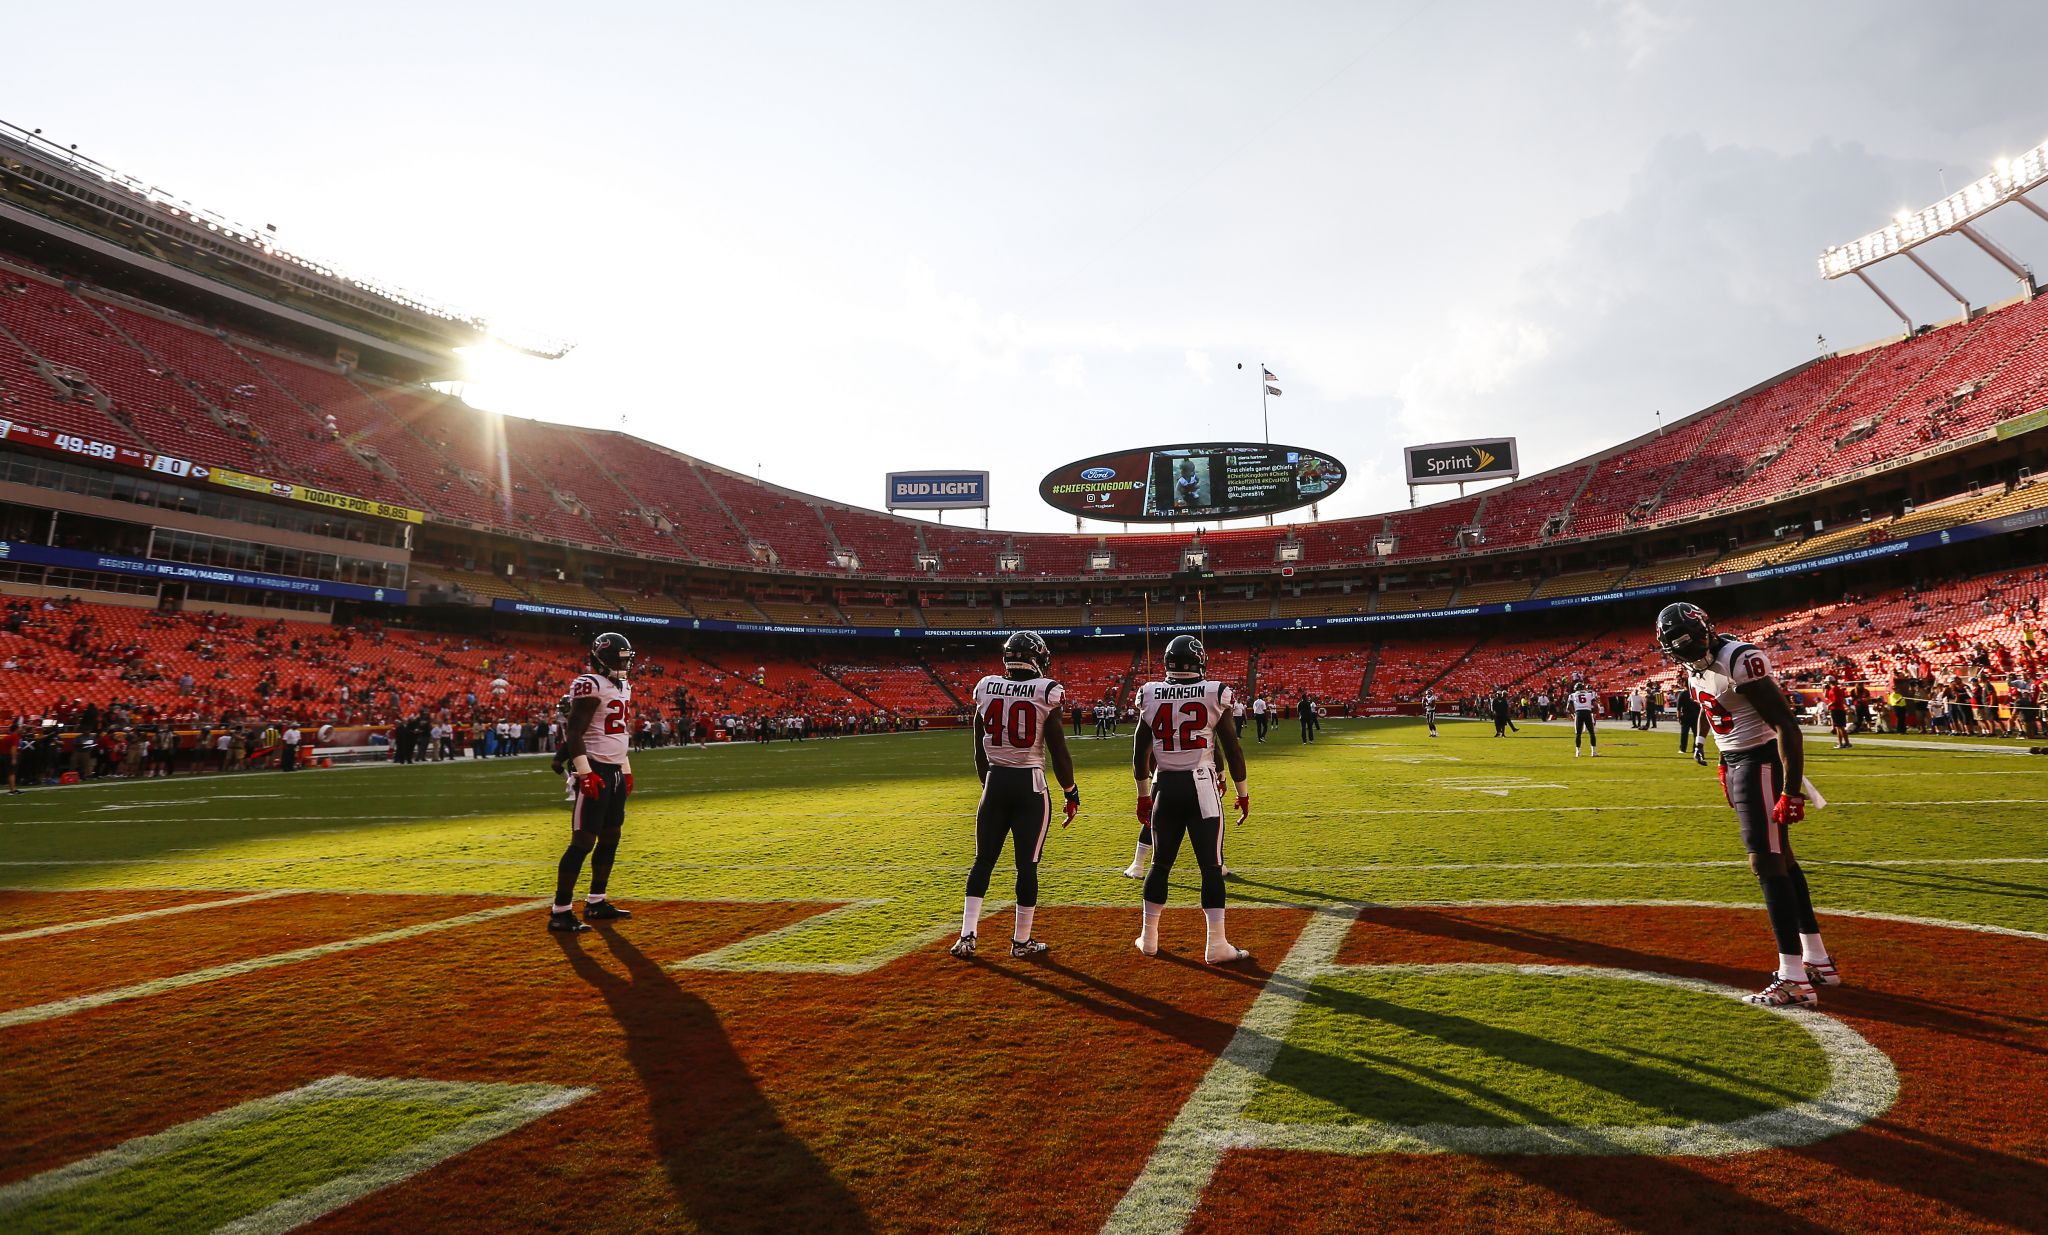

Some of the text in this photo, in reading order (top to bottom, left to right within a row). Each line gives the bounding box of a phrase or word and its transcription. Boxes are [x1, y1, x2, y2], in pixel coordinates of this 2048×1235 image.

[54, 434, 116, 459] 49:58
[171, 460, 180, 473] 0
[1428, 454, 1472, 474] Sprint
[1087, 470, 1109, 478] Ford
[896, 482, 978, 495] BUD LIGHT
[1052, 482, 1132, 494] #CHIEFSKINGDOM
[304, 489, 346, 507] TODAY'S
[349, 499, 371, 512] POT:
[377, 505, 408, 519] $8,851
[2003, 514, 2036, 527] REGISTER
[1747, 570, 1774, 579] REPRESENT
[1785, 565, 1801, 573] CHIEFS
[1818, 557, 1838, 566] MADDEN
[1869, 542, 1909, 556] CHAMPIONSHIP
[98, 558, 144, 570] REGISTER
[158, 566, 234, 582] NFL.COM/MADDEN
[237, 575, 254, 584] NOW
[256, 577, 290, 588] THROUGH
[292, 582, 309, 590] SEPT
[1581, 593, 1624, 602] NFL.COM/MADDEN
[516, 604, 545, 613] REPRESENT
[636, 616, 669, 624] CHAMPIONSHIP
[1742, 656, 1766, 679] 18
[574, 682, 592, 696] 28
[986, 682, 1036, 697] COLEMAN
[1155, 686, 1205, 700] SWANSON
[1578, 694, 1586, 703] 6
[984, 698, 1037, 748] 40
[1152, 702, 1208, 751] 42
